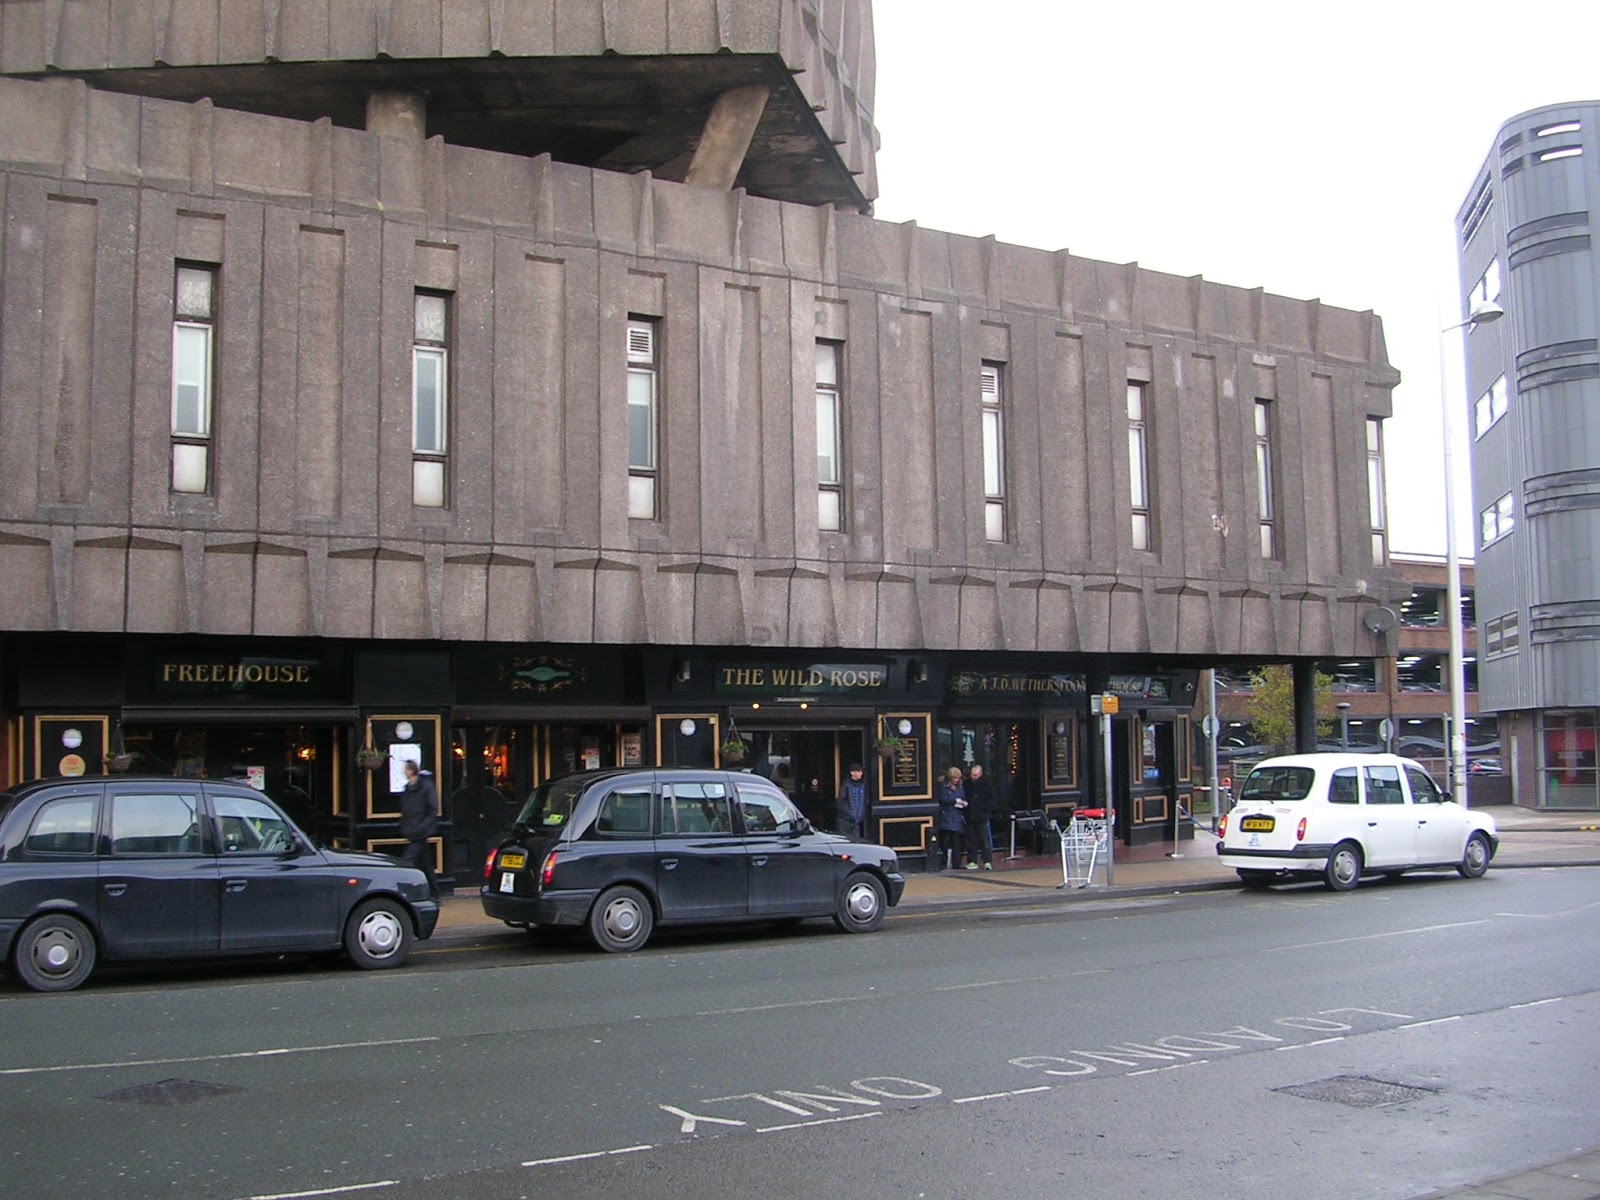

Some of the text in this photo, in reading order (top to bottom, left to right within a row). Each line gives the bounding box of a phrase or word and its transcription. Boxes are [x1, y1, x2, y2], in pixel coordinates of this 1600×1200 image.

[163, 664, 310, 683] FREEHOUSE
[723, 668, 881, 687] THE WILD ROSE
[979, 677, 988, 690] A
[659, 1007, 1414, 1132] LOADING ONLY
